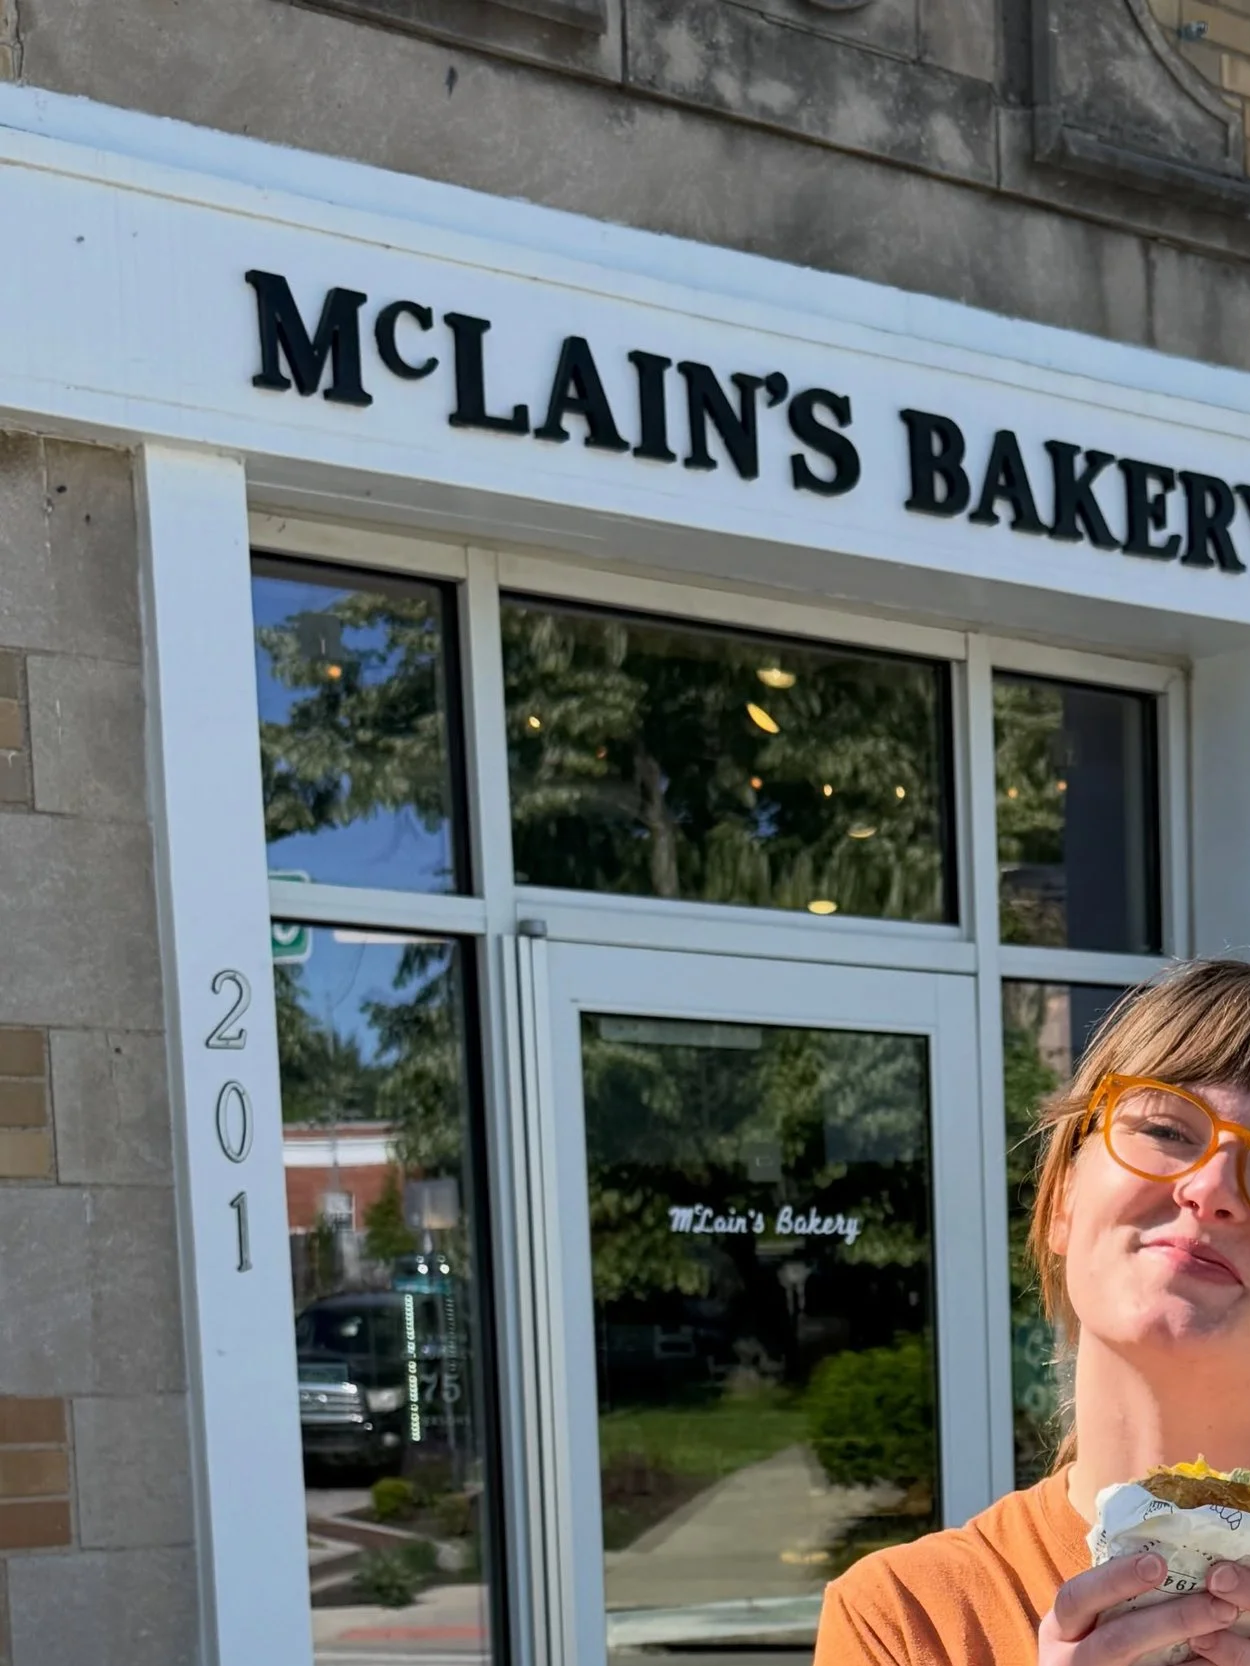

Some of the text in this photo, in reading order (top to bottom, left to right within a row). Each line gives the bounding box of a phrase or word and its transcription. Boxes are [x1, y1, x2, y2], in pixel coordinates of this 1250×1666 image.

[205, 969, 254, 1273] 201
[776, 1205, 862, 1246] Bakery
[420, 1373, 461, 1403] 75
[1163, 1575, 1198, 1592] 194
